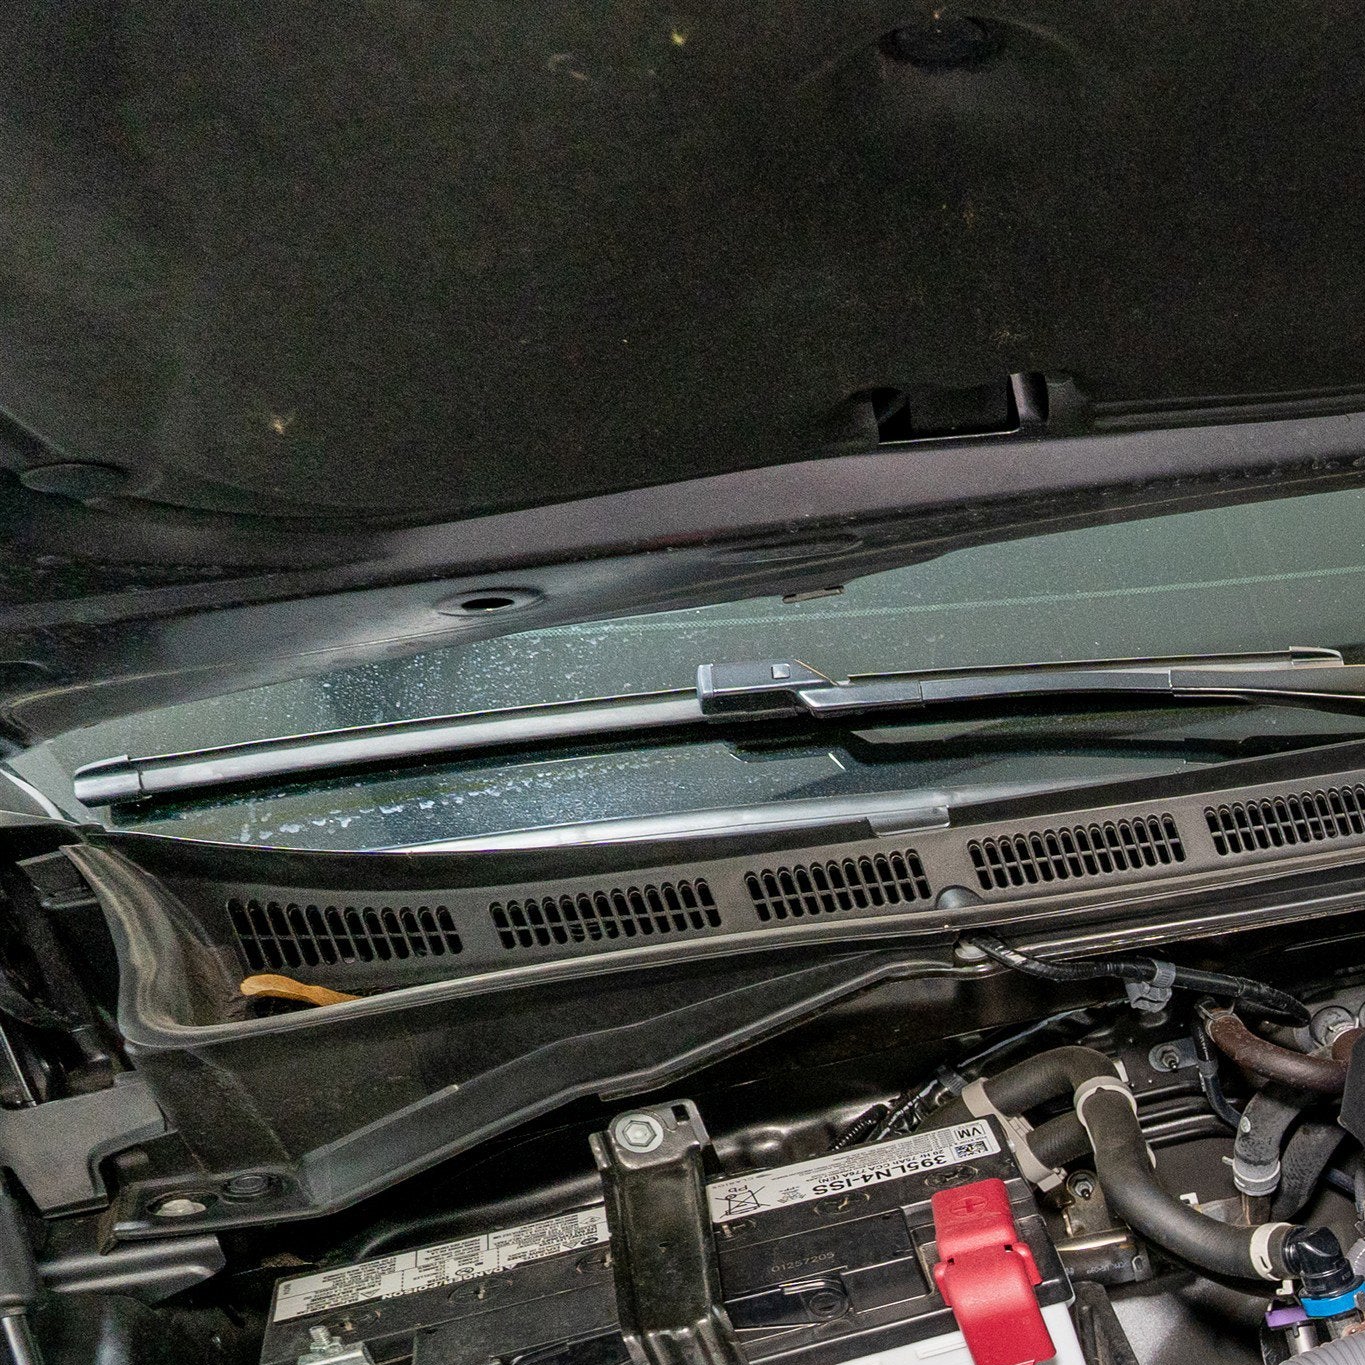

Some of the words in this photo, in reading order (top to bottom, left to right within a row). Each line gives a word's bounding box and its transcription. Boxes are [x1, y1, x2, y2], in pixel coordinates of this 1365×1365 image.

[957, 1125, 981, 1139] VM
[867, 1162, 890, 1171] CCA
[811, 1153, 947, 1196] 395LN4-ISS
[726, 1184, 747, 1194] Pb
